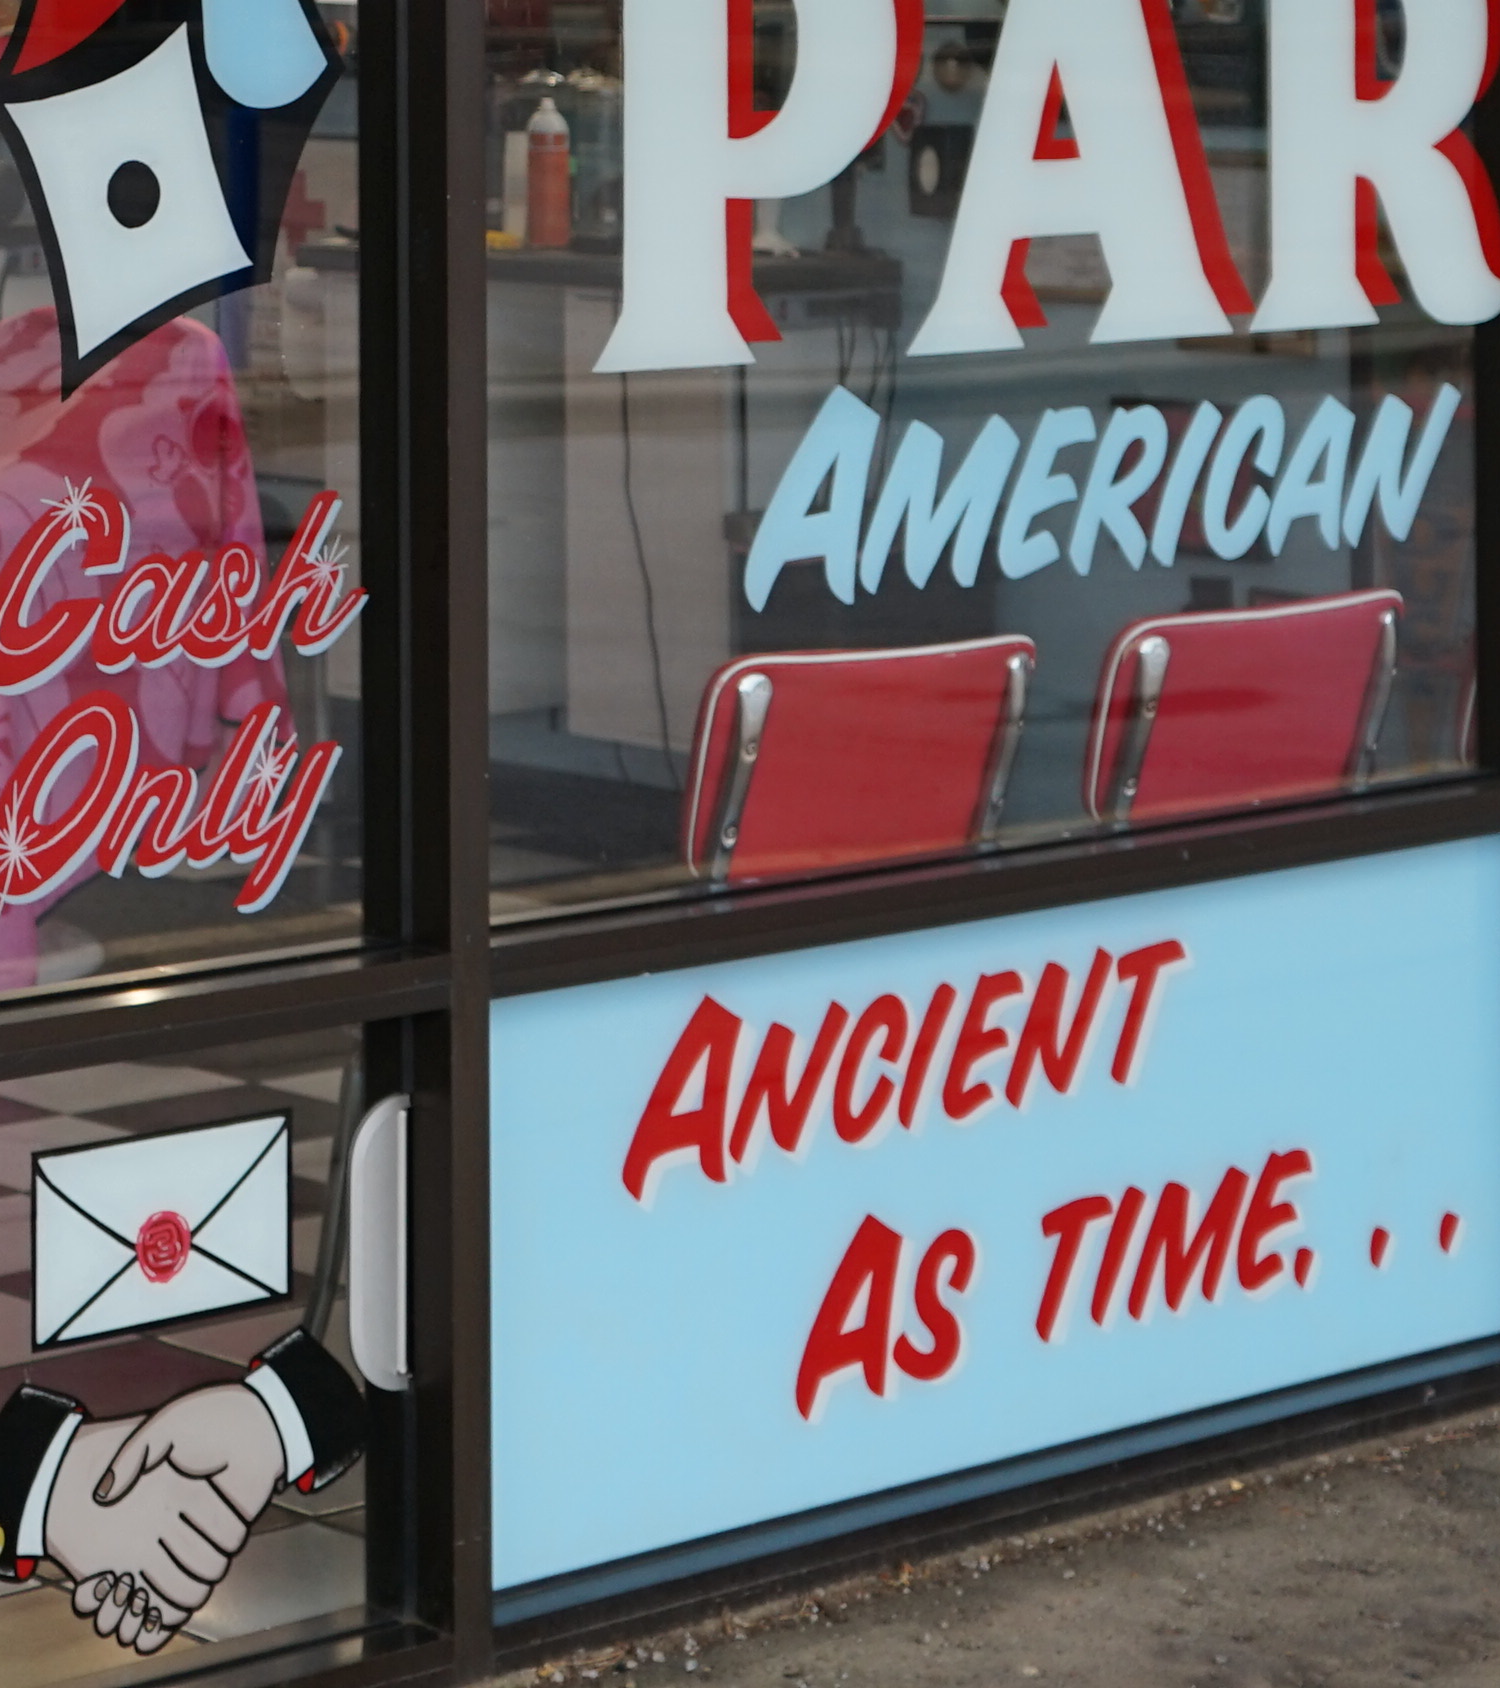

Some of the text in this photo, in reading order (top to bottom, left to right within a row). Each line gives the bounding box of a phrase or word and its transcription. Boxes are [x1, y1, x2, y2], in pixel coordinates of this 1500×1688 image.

[743, 380, 1461, 613] AMERICAN
[622, 938, 1187, 1208] ANCIENT
[795, 1213, 976, 1423] AS
